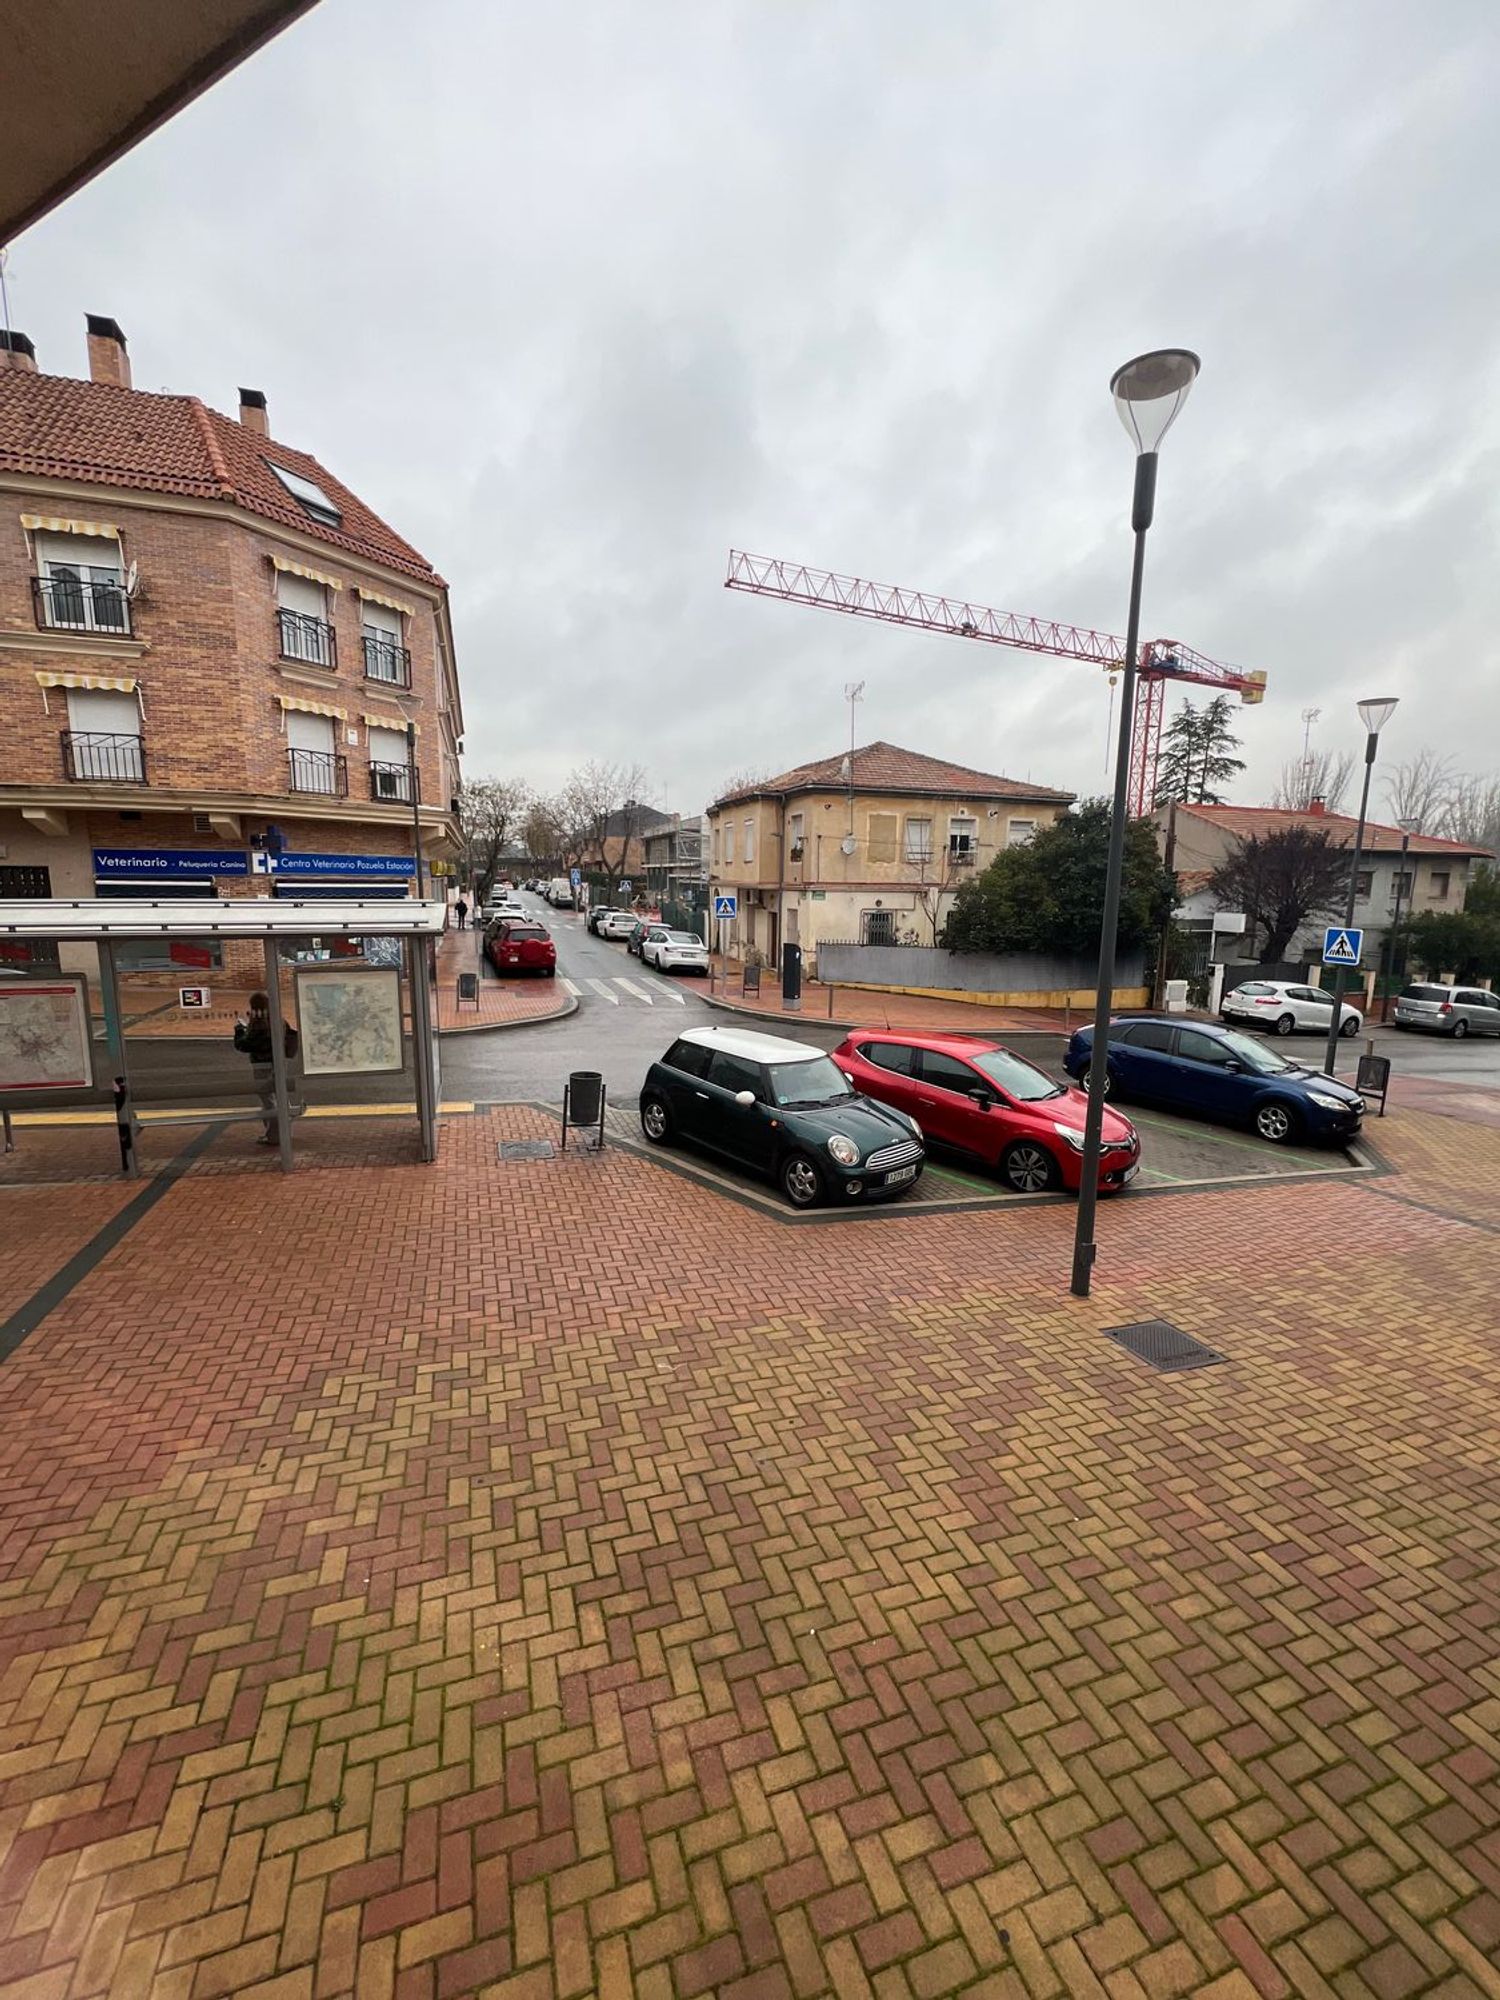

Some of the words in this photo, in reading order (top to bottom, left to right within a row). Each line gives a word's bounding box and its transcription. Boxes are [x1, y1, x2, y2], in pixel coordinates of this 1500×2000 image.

[97, 855, 168, 867] Veterinario
[220, 860, 247, 868] Canina
[281, 857, 311, 868] Centro
[311, 858, 356, 869] Veterinario
[356, 860, 385, 870] Pozuelo
